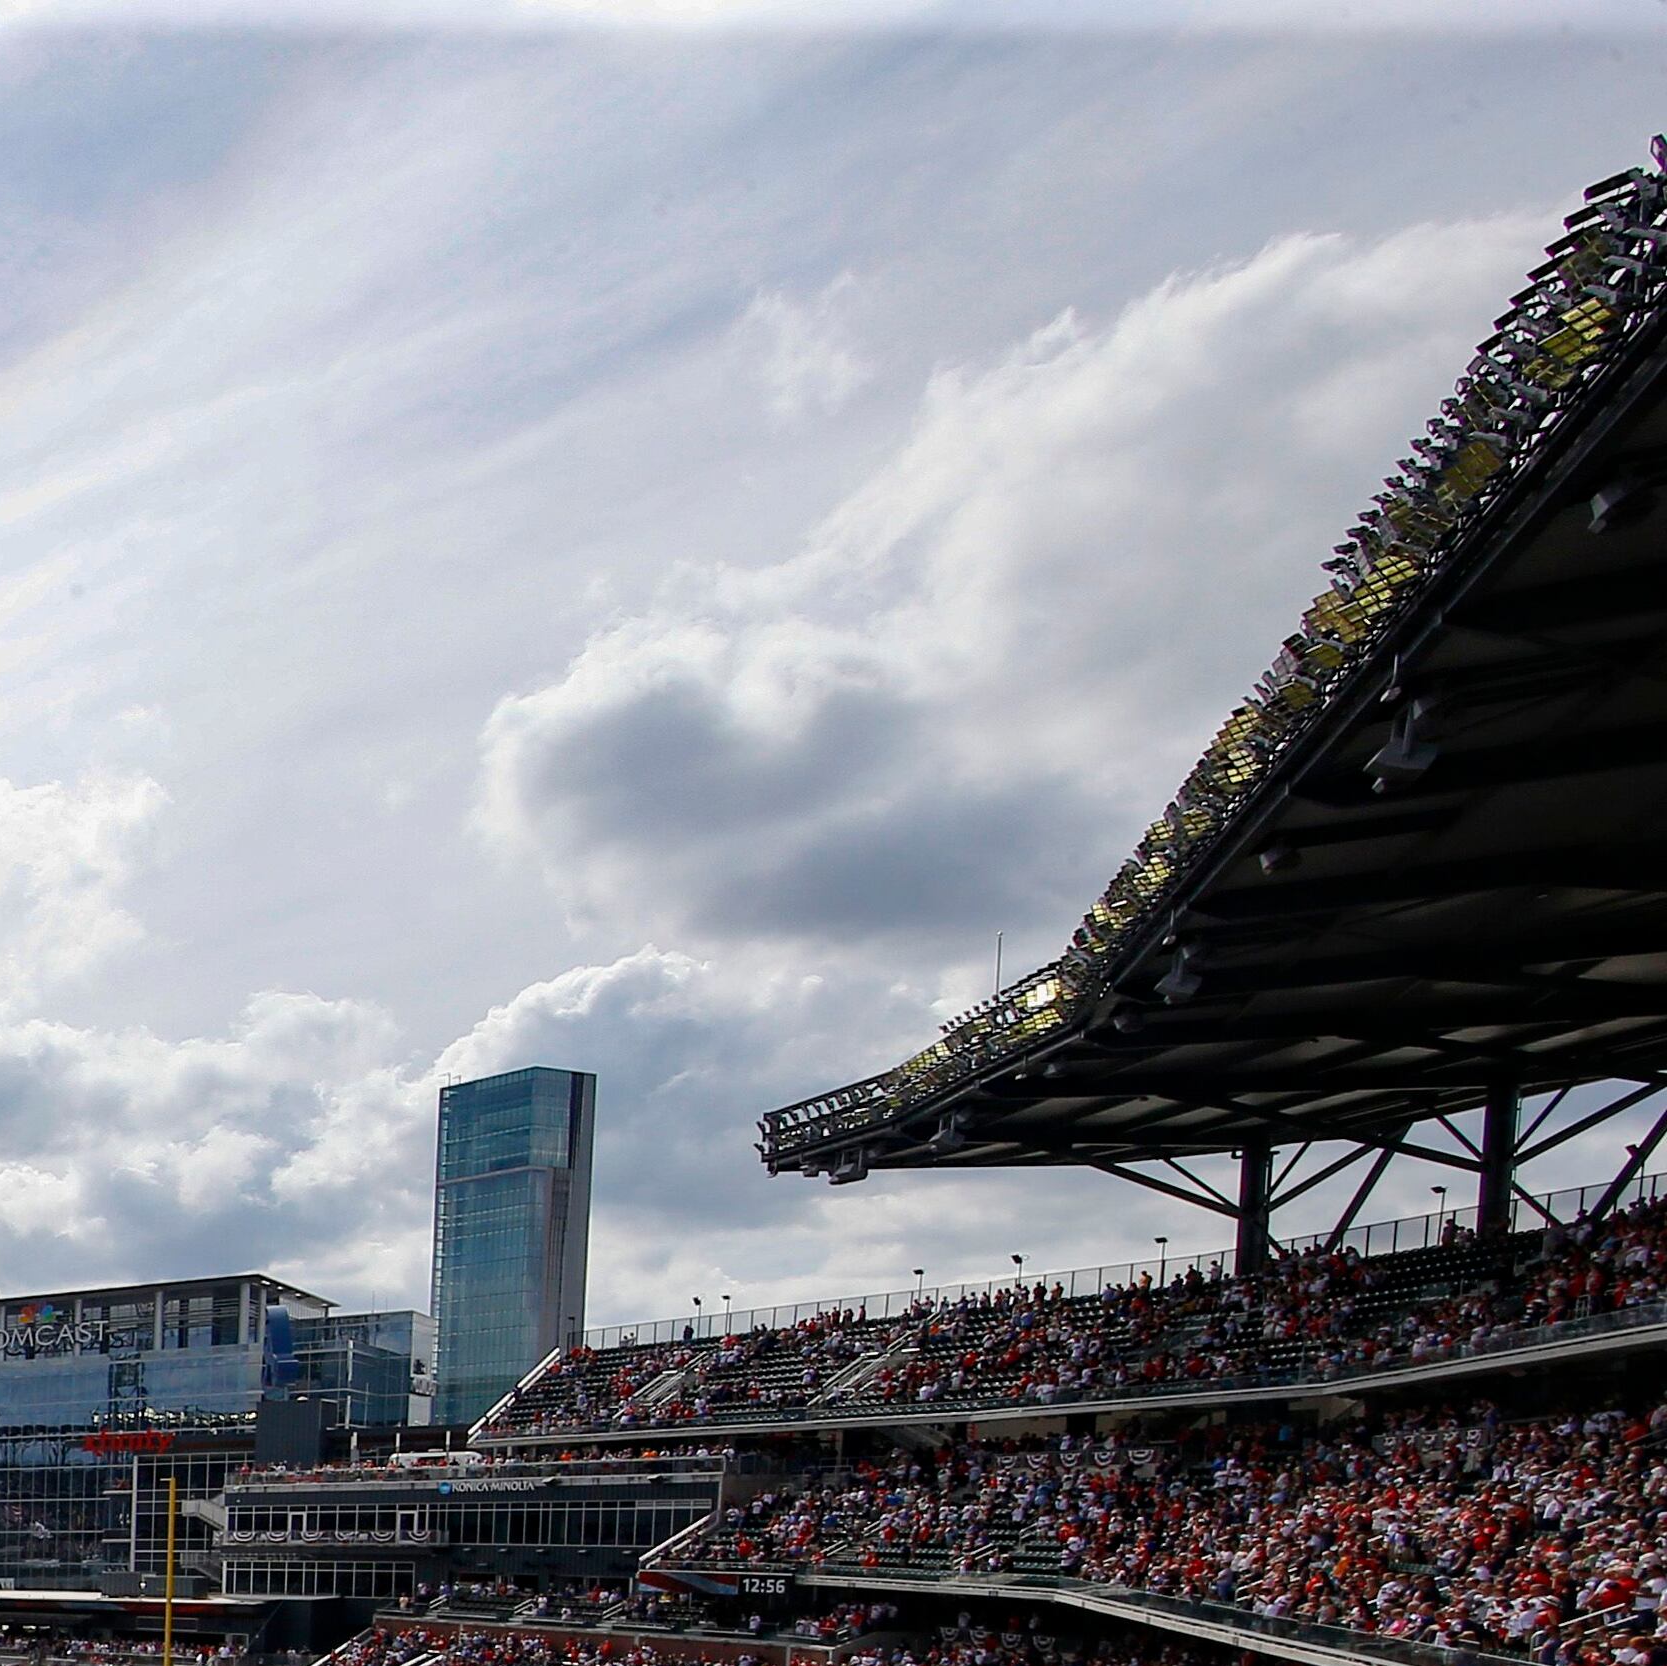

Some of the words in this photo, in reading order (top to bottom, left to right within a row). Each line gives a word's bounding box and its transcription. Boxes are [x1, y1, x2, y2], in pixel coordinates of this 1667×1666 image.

[452, 1480, 487, 1493] KONICA
[489, 1479, 535, 1492] MINOLTA
[741, 1578, 786, 1594] 12:56
